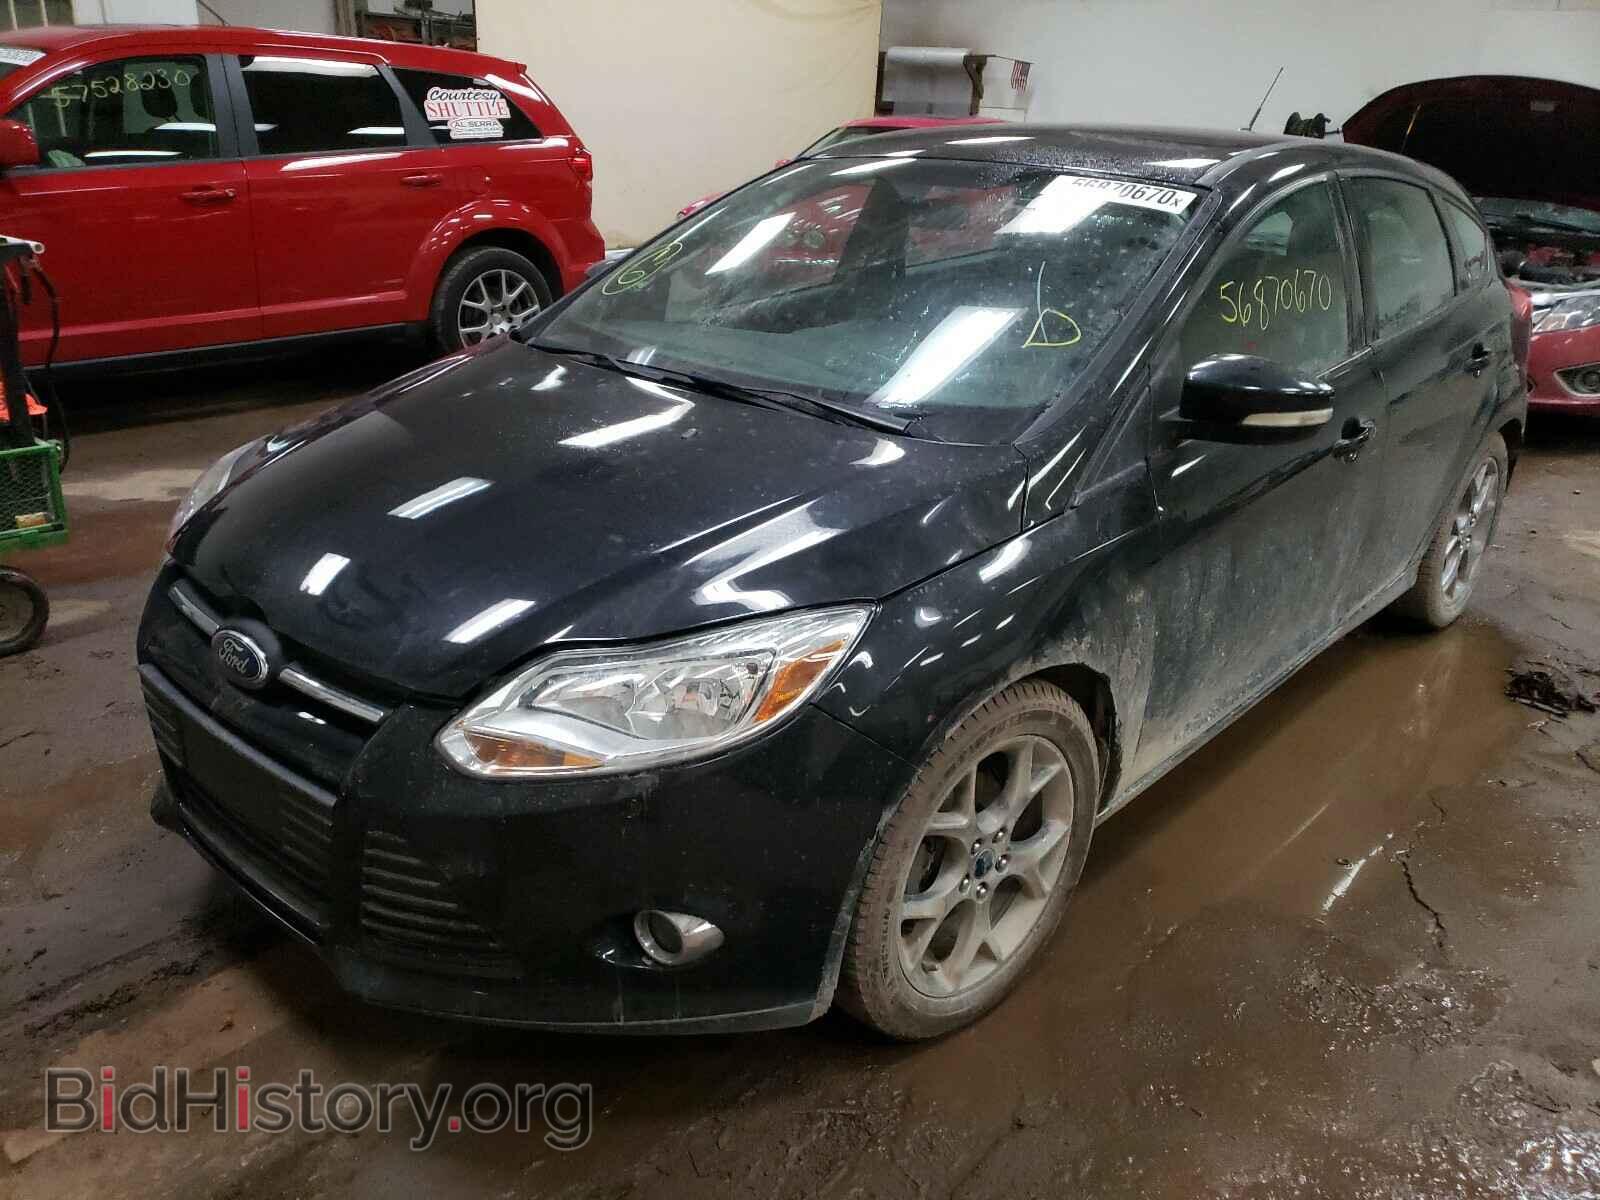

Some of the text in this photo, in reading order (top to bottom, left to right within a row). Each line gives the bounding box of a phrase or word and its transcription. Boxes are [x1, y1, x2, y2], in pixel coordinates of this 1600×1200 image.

[51, 69, 191, 108] 57528230
[430, 89, 498, 108] Courtesy
[427, 101, 509, 118] SHUTTLE
[1219, 268, 1332, 331] 56870670
[218, 638, 250, 674] Ford
